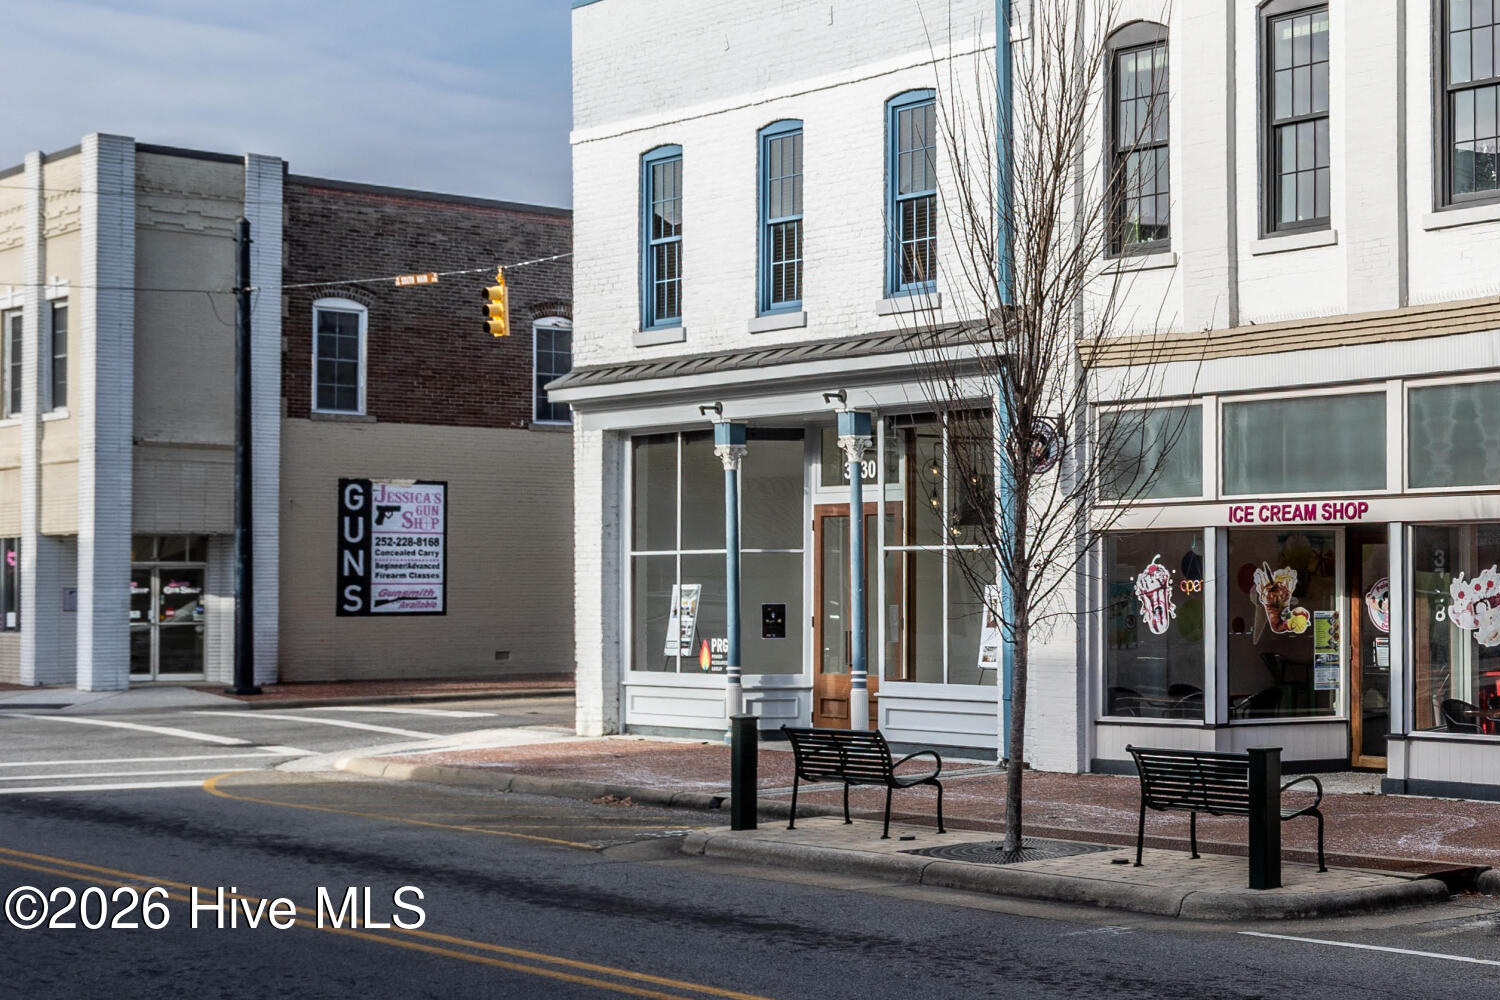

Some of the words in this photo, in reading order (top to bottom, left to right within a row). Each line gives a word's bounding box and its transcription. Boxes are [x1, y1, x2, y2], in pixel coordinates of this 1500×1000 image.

[844, 460, 876, 479] 330
[415, 505, 439, 516] GUN
[1228, 505, 1254, 523] ICE
[1259, 504, 1317, 522] CREAM
[1321, 501, 1369, 521] SHOP
[343, 483, 364, 612] GUNS
[375, 537, 440, 547] 252-228-8168
[374, 549, 416, 557] Concealed
[418, 549, 440, 558] Carry
[378, 588, 435, 598] Gunsmith
[711, 638, 728, 653] PRG
